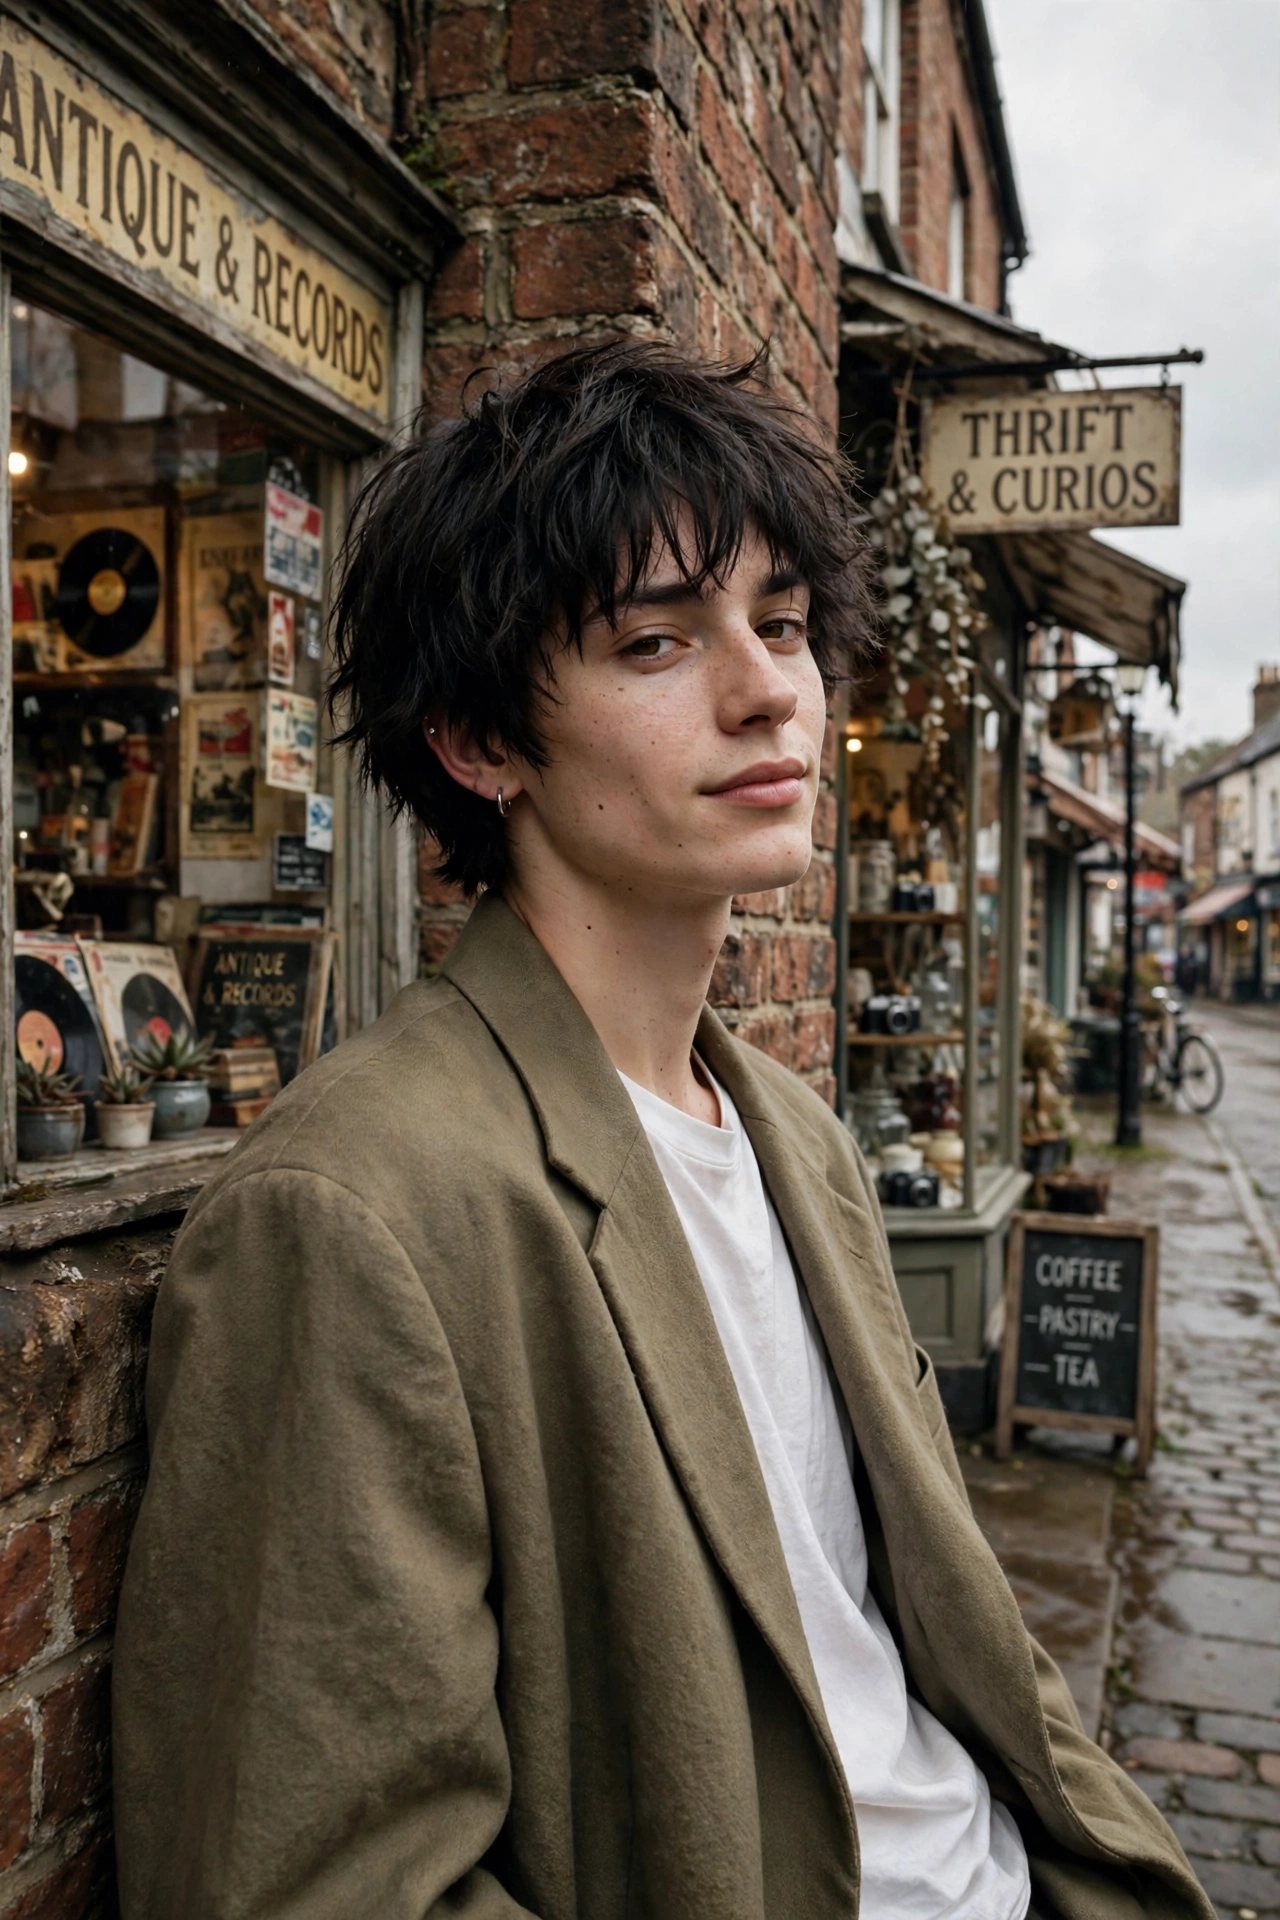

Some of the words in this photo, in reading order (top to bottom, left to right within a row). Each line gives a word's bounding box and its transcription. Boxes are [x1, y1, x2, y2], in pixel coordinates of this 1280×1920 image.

[0, 50, 200, 278] ANTIQUE
[214, 216, 240, 304] &
[252, 236, 384, 394] RECORDS
[962, 403, 1133, 458] THRIFT
[947, 469, 976, 516] &
[992, 461, 1158, 515] CURIOS
[214, 951, 286, 978] ANTIQUE
[221, 981, 298, 1007] RECORDS
[1036, 1254, 1122, 1291] COFFEE
[1039, 1305, 1120, 1340] PASTRY
[1054, 1354, 1099, 1388] TEA
